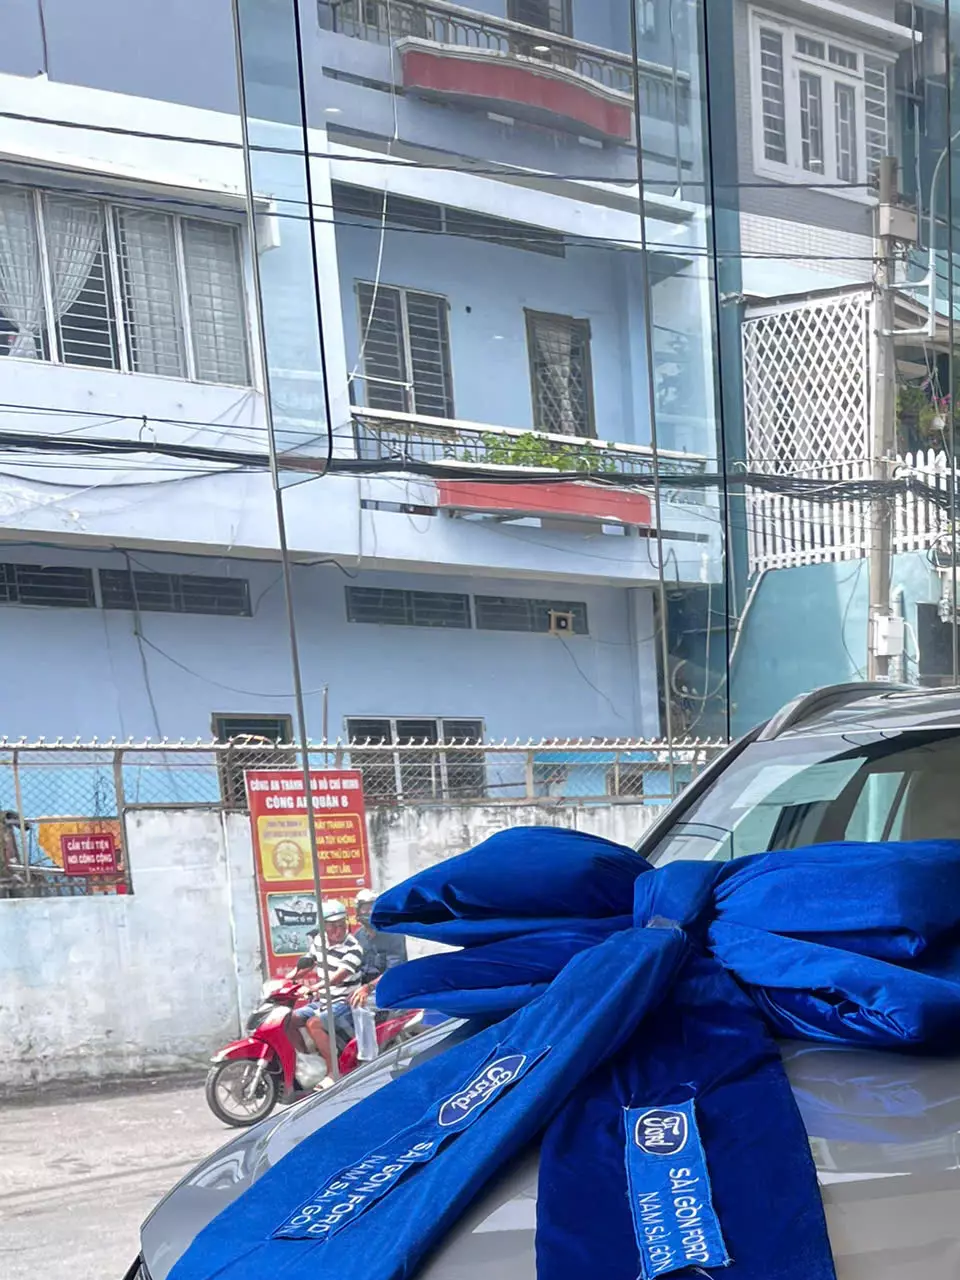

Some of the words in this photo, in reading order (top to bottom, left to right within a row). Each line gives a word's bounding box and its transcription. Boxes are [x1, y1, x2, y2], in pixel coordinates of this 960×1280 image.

[265, 795, 294, 809] CÔNG
[451, 1066, 513, 1112] Ford
[643, 1116, 682, 1147] Ford
[342, 1155, 387, 1181] NAM
[669, 1167, 699, 1194] SÀI
[307, 1194, 366, 1234] FORD
[638, 1191, 664, 1225] NAM
[673, 1197, 704, 1230] GÒN
[644, 1225, 672, 1244] SÀI
[680, 1230, 710, 1264] FORD
[648, 1243, 677, 1274] GÒN
